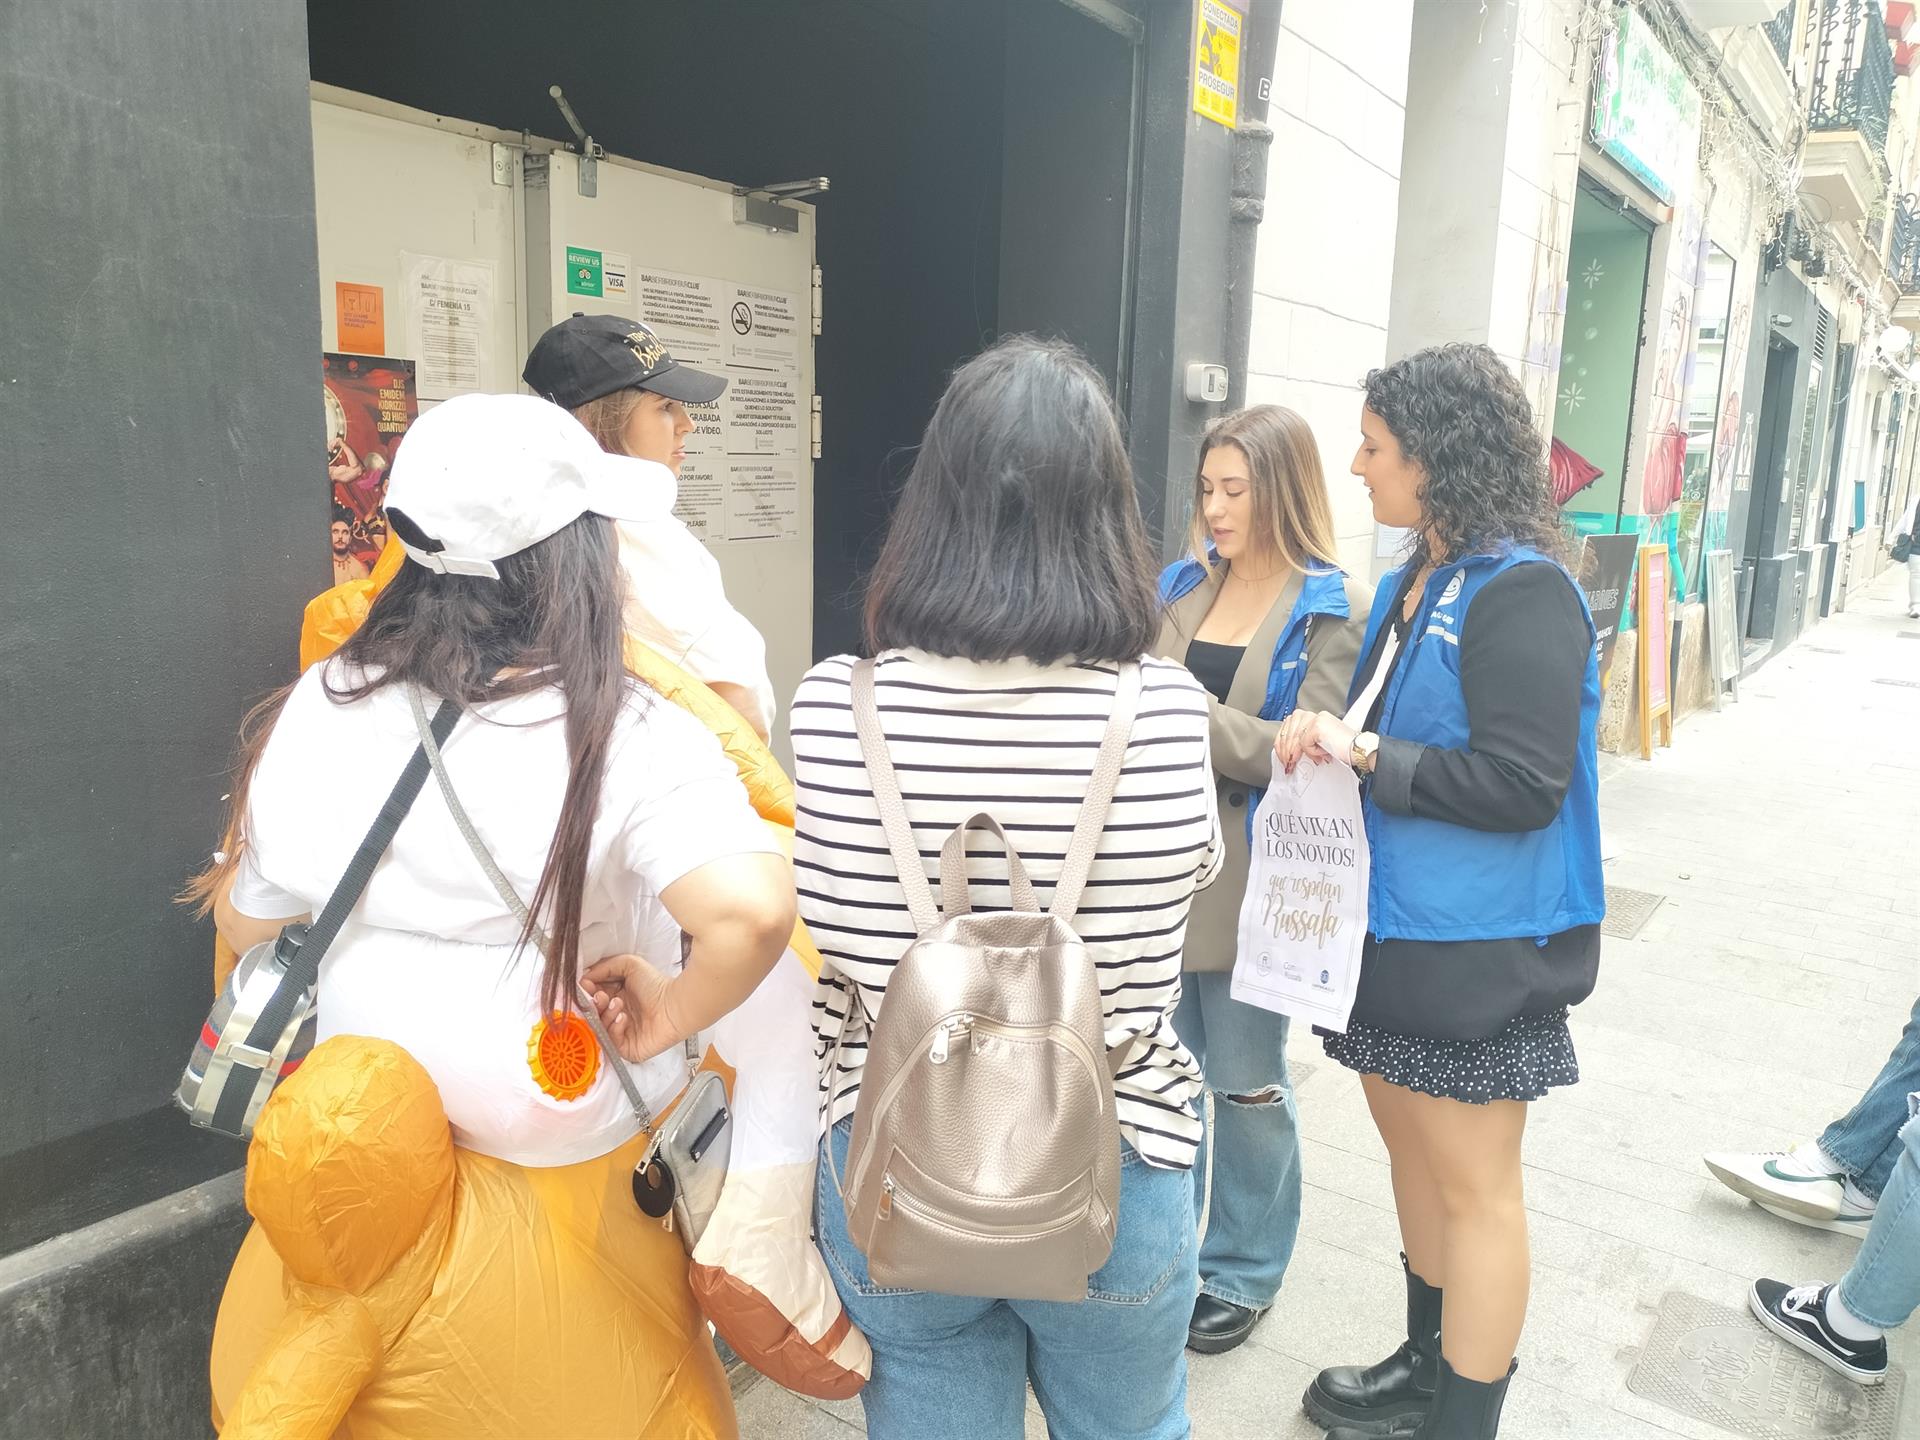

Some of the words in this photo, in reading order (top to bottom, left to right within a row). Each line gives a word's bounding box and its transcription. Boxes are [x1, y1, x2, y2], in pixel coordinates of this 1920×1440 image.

[1204, 1, 1238, 28] CONECTADA
[1198, 71, 1235, 100] PROSEGUR
[568, 254, 590, 264] REVIEW
[608, 277, 624, 288] VISA
[393, 379, 405, 389] DJS
[382, 411, 390, 421] SO
[392, 412, 407, 422] HIGH
[690, 413, 721, 422] GRABADA
[378, 422, 407, 432] QUANTUM
[1266, 809, 1298, 837] ¡QUÉ
[1297, 816, 1353, 839] VIVAN
[1266, 840, 1293, 859] LOS
[1295, 842, 1355, 868] NOVIOS!
[1269, 874, 1288, 898] que
[1290, 872, 1344, 903] respetan
[1261, 892, 1344, 950] Russafa
